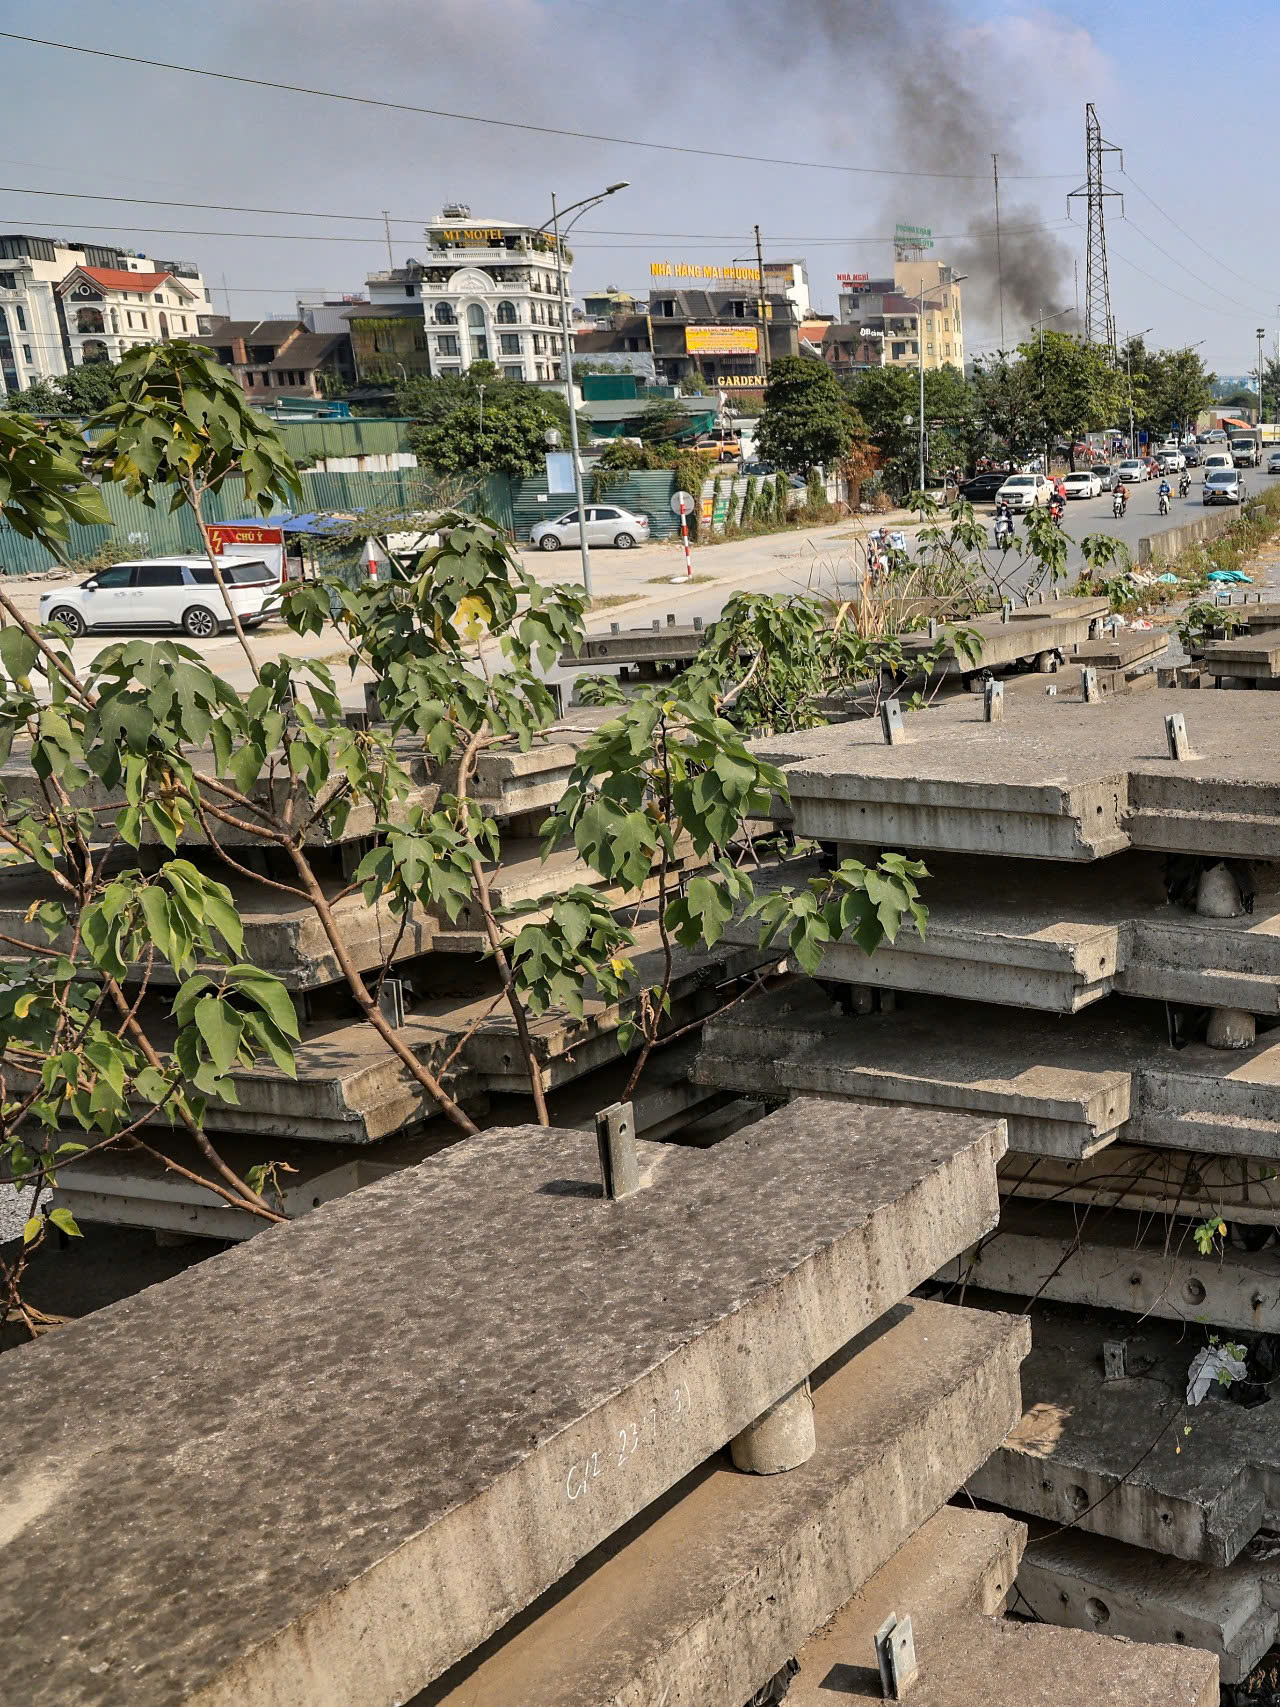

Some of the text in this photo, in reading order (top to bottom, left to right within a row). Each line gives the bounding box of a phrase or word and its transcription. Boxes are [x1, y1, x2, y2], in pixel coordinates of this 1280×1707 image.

[463, 229, 505, 241] MOTEL
[650, 260, 672, 277] NHÀ
[673, 261, 701, 278] HÀNG
[703, 266, 721, 279] MAI
[235, 531, 255, 542] CHÚ
